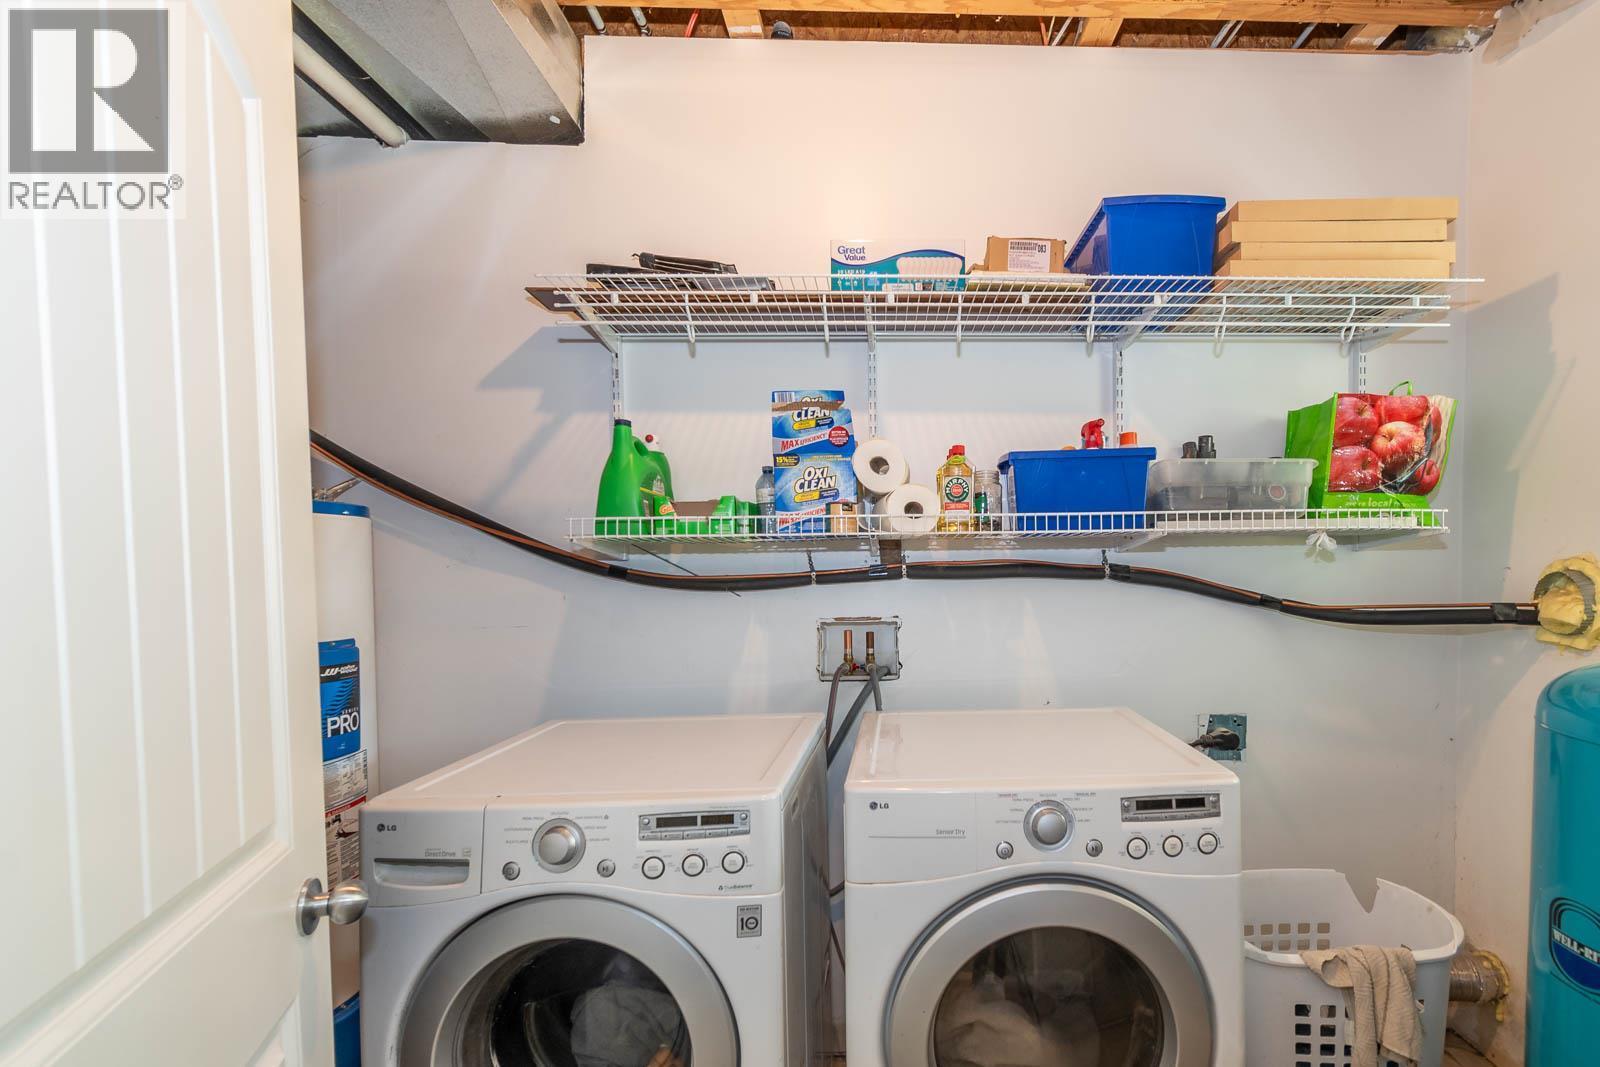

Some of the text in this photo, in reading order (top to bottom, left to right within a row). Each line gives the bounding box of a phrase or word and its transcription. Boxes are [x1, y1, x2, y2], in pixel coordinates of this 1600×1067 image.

[837, 245, 866, 255] Great
[793, 406, 831, 422] CLEAN
[781, 439, 799, 452] MAX
[803, 466, 828, 480] OXI
[794, 475, 837, 493] CLEAN
[945, 478, 969, 494] MURPHY
[1368, 497, 1392, 507] local
[327, 711, 360, 738] PRO
